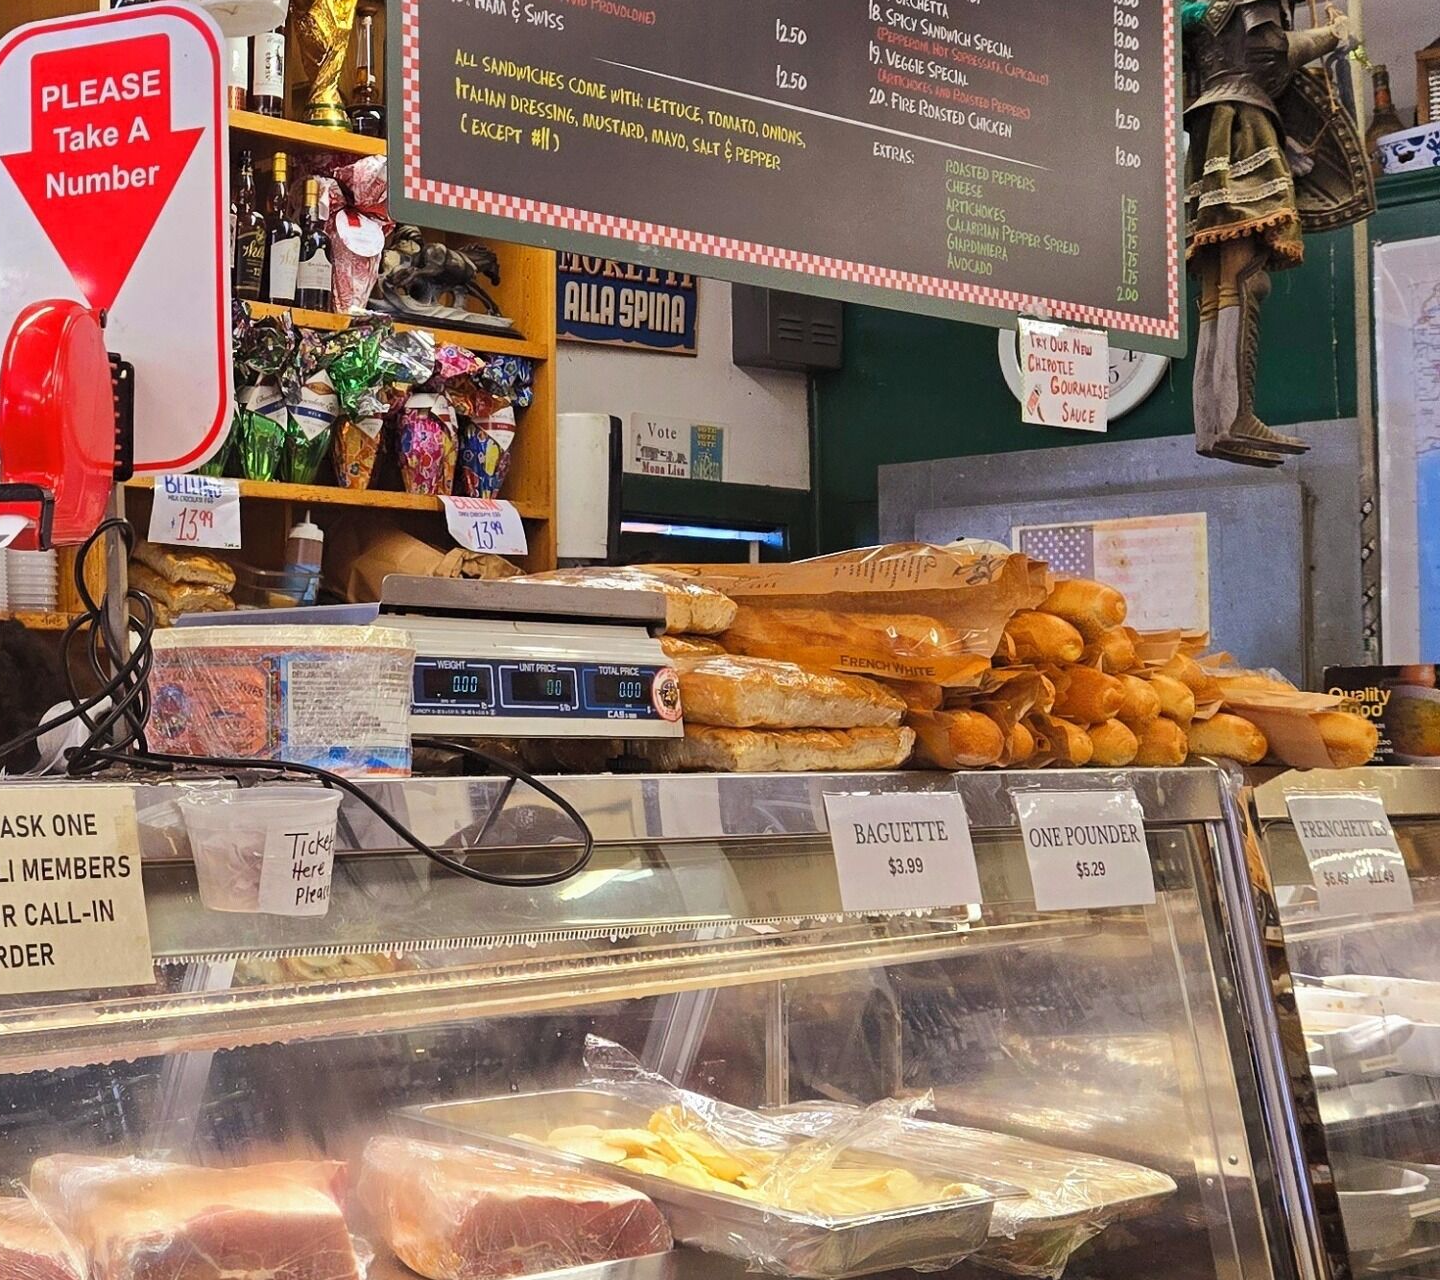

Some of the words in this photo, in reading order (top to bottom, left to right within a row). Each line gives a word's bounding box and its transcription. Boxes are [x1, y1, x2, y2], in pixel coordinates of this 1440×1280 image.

[524, 4, 566, 32] SWISS
[41, 69, 162, 112] PLEASE
[455, 48, 479, 68] ALL
[482, 55, 565, 91] SANDWICHES
[568, 76, 607, 101] COME
[610, 87, 644, 110] WITH:
[647, 95, 705, 126] LETTUCE,
[707, 109, 759, 140] TOMATO,
[761, 122, 807, 150] ONIONS,
[868, 86, 889, 107] 20.
[890, 91, 917, 117] FIRE
[918, 98, 966, 129] ROASTED
[967, 110, 1013, 139] CHICKEN
[53, 125, 119, 154] Take
[129, 116, 150, 142] A
[872, 140, 915, 165] EXTRAS:
[44, 163, 160, 200] Number
[563, 280, 615, 327] ALLA
[619, 283, 687, 335] SPINA
[1028, 330, 1048, 354] TRY
[1049, 336, 1071, 354] OUR
[1072, 341, 1094, 358] NEW
[1027, 353, 1075, 378] CHIPOTLE
[1049, 374, 1110, 401] GOURMAISE
[1061, 402, 1096, 424] SAUCE
[646, 422, 678, 441] Vote
[641, 460, 664, 476] Mona
[518, 662, 535, 673] UNIT
[535, 663, 557, 674] PRICE
[839, 653, 888, 675] FRENCH
[889, 660, 936, 678] WHITE
[1328, 686, 1392, 706] Quality
[0, 814, 47, 838] ASK
[52, 812, 99, 837] ONE
[853, 819, 950, 846] BAGUETTE
[1028, 827, 1064, 849] ONE
[1064, 824, 1141, 847] POUNDER
[21, 854, 132, 882] MEMBERS
[291, 862, 325, 880] Here
[887, 856, 924, 877] $3.99
[1075, 860, 1106, 880] $5.29
[24, 898, 116, 927] CALL-IN
